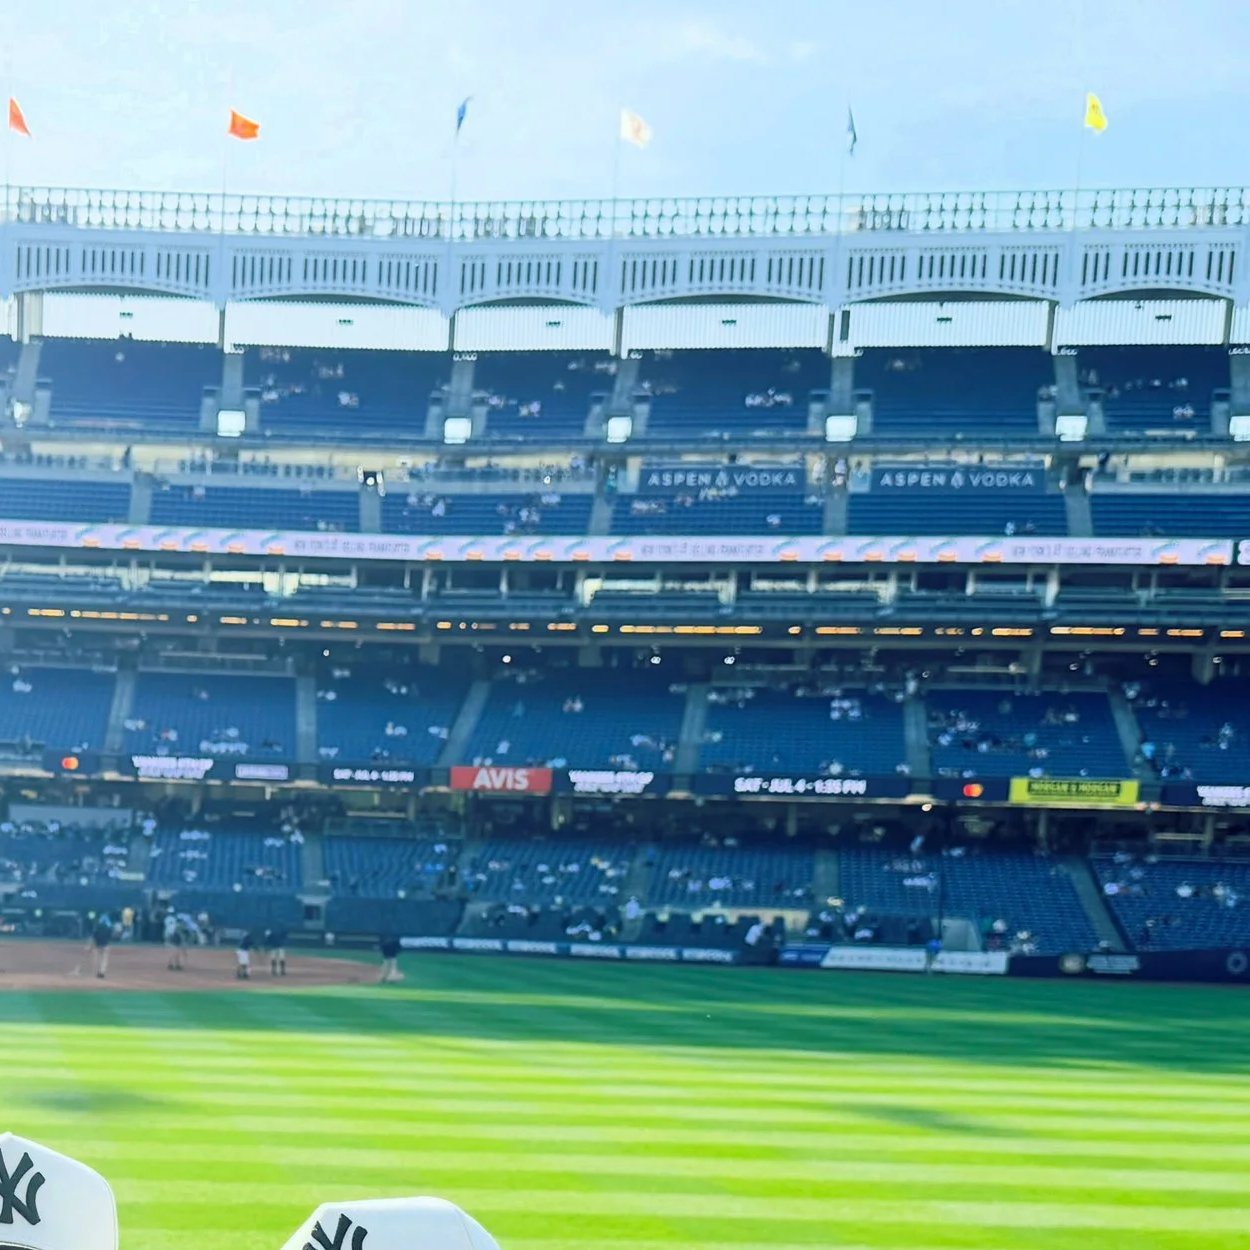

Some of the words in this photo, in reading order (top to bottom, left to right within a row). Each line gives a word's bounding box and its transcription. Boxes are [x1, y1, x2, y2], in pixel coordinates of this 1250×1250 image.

[648, 471, 711, 487] ASPEN
[734, 471, 797, 487] VODKA
[880, 471, 946, 488] ASPEN
[969, 471, 1035, 488] VODKA
[473, 768, 529, 790] AVIS
